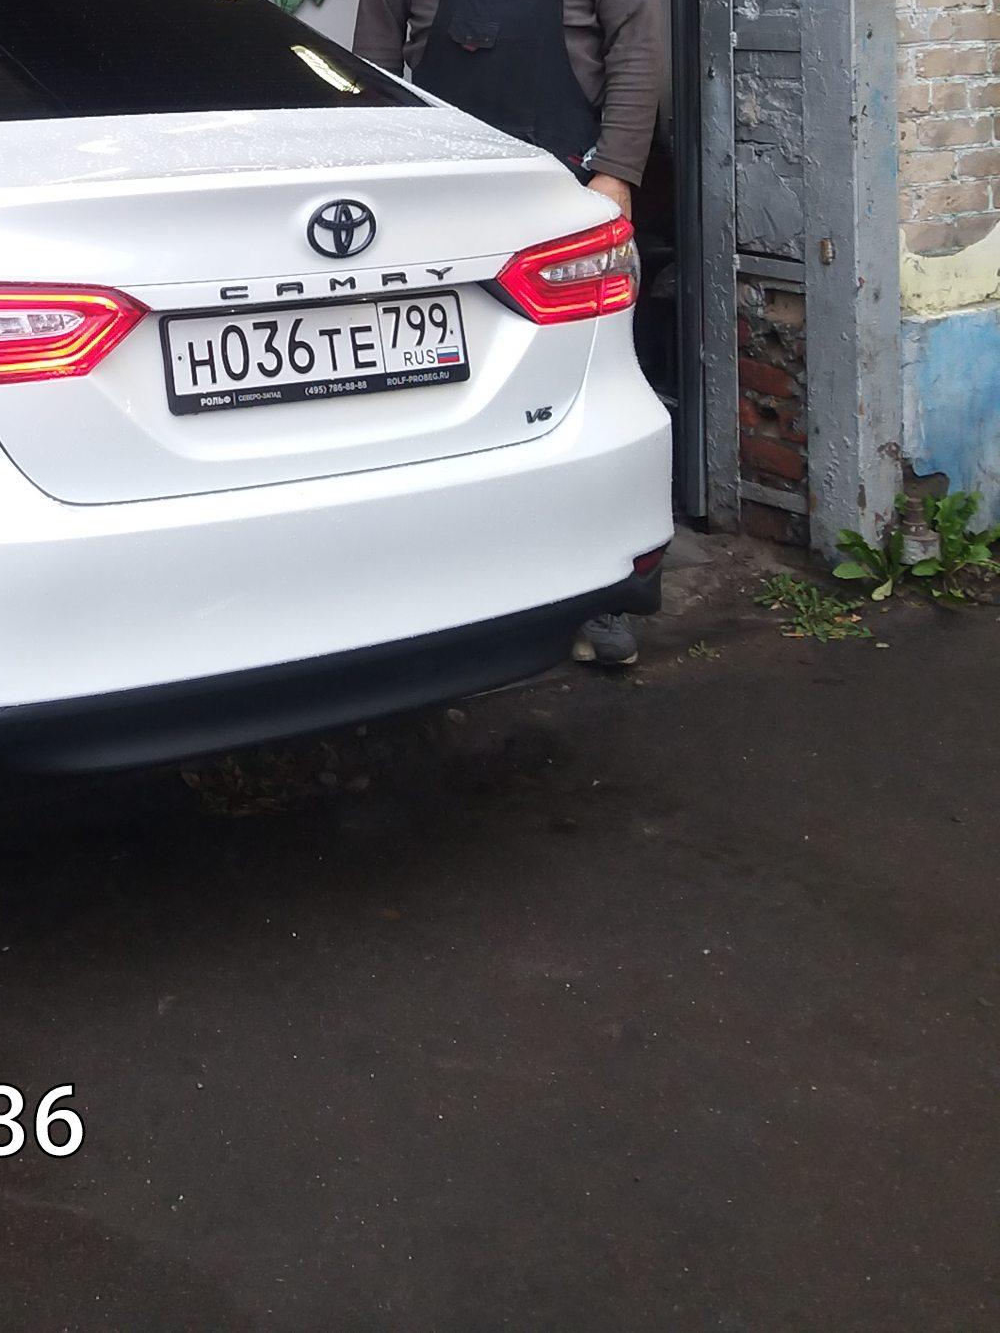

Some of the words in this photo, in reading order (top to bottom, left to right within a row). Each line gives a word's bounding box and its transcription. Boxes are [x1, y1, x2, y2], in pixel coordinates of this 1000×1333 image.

[219, 266, 454, 301] CAMRY
[187, 318, 378, 387] Н036ТЕ
[382, 303, 449, 349] 799
[403, 349, 437, 367] RUS
[386, 371, 450, 386] ROLF-PROBEG.RU
[304, 385, 328, 396] (495)
[201, 396, 232, 407] РОЛЬФ
[525, 405, 553, 424] V6
